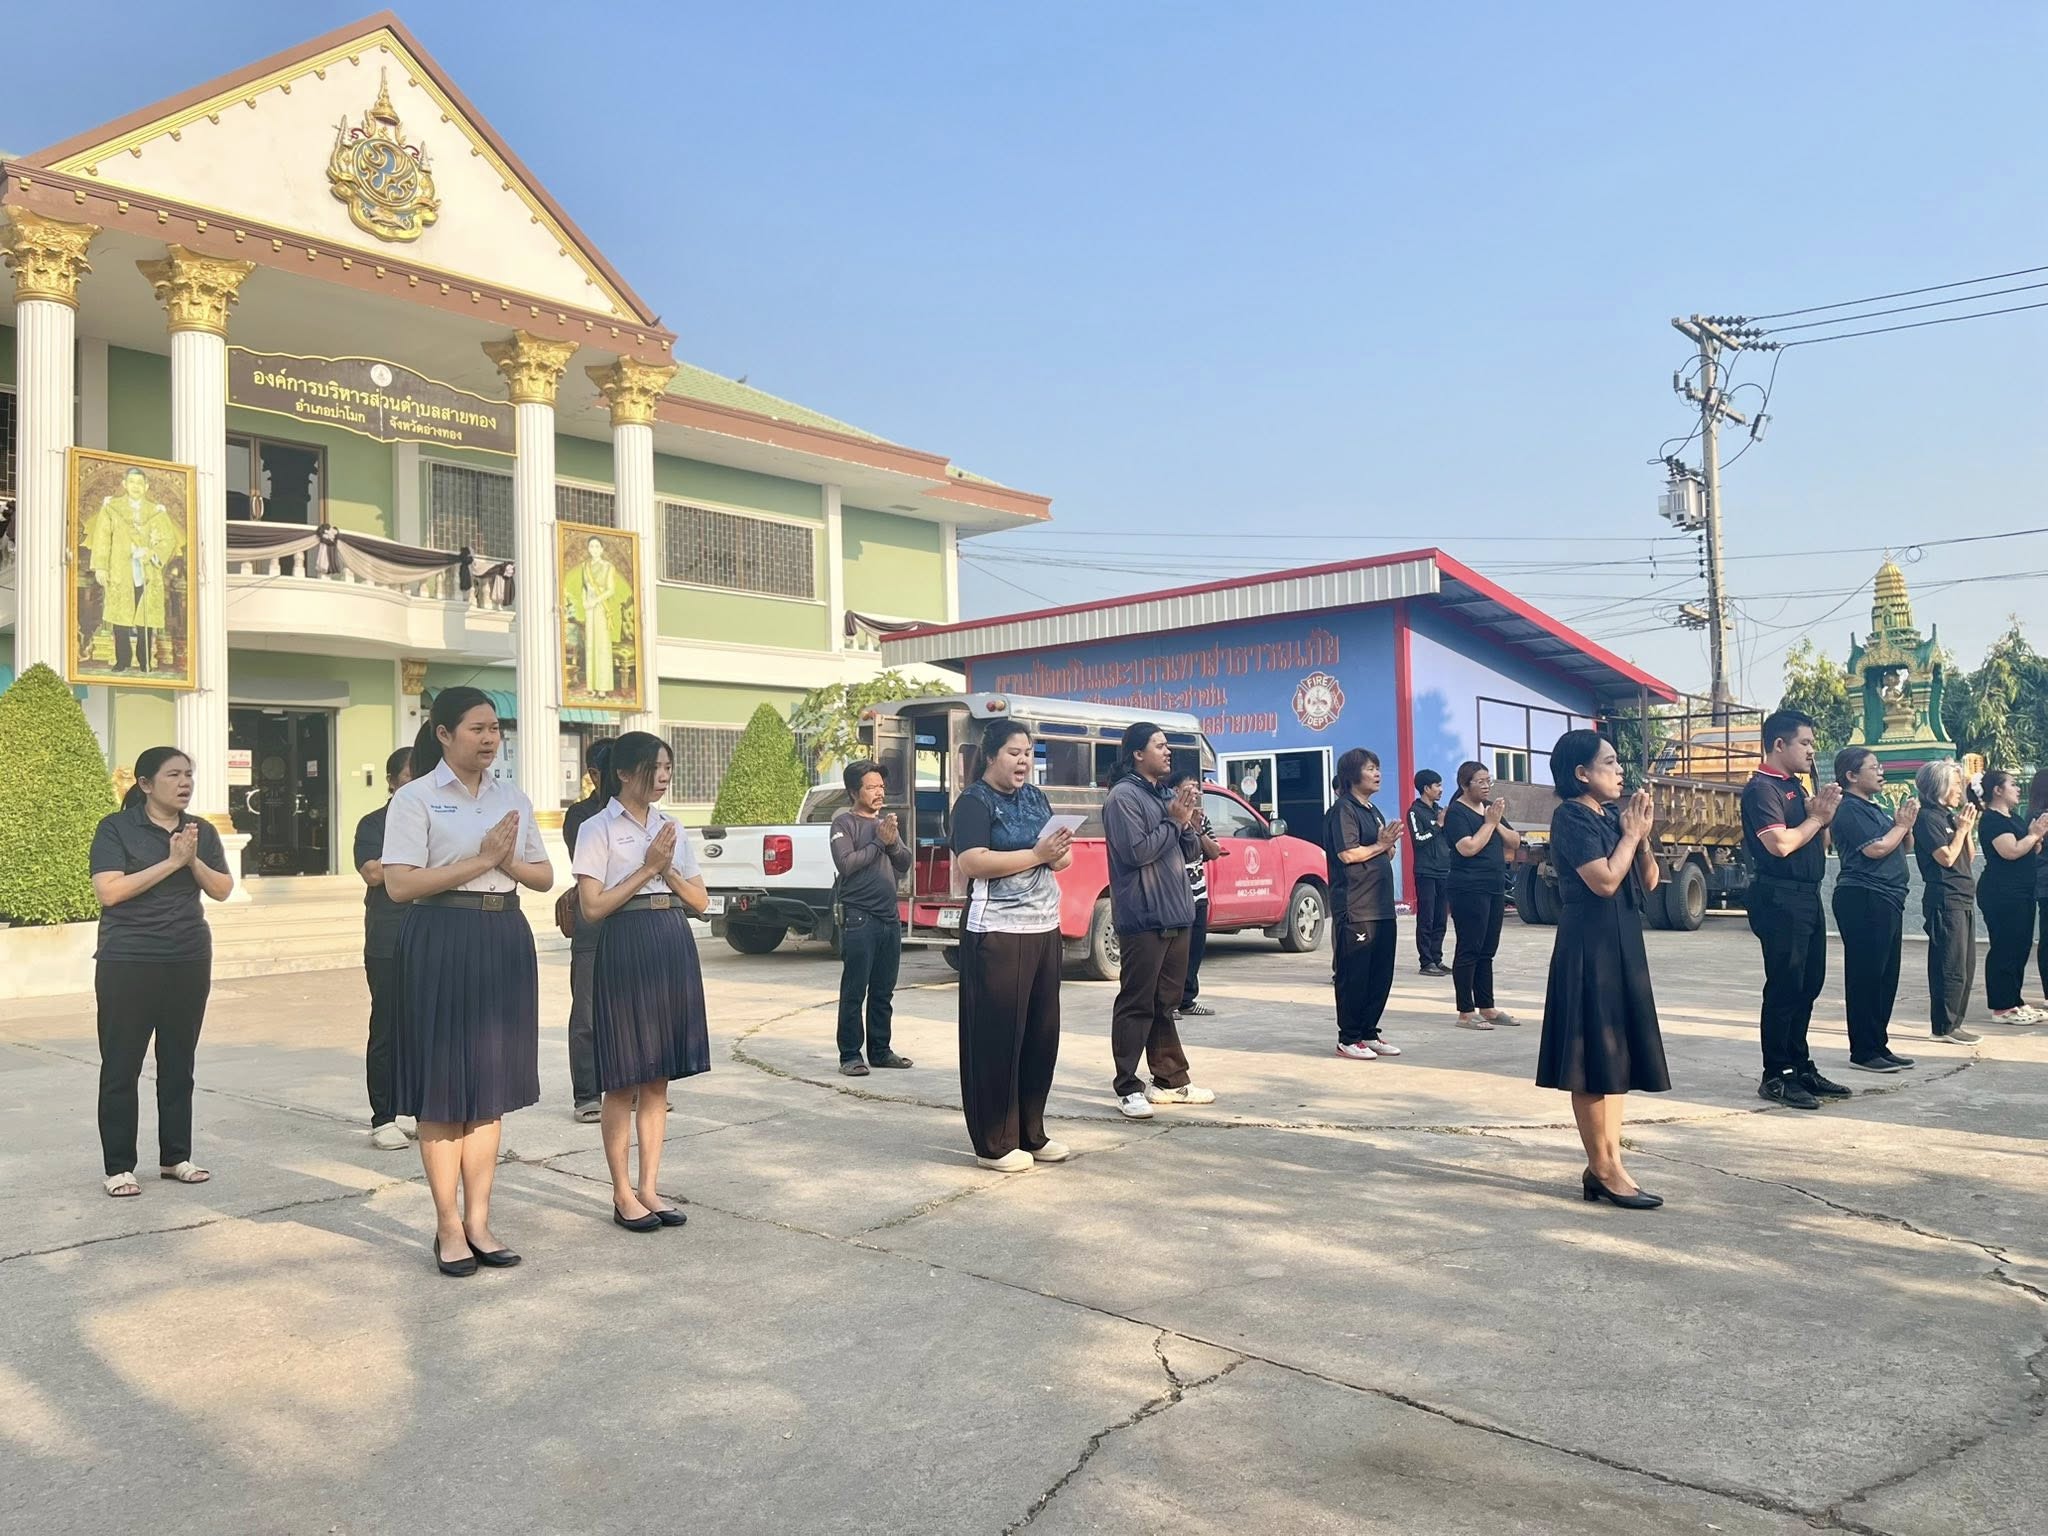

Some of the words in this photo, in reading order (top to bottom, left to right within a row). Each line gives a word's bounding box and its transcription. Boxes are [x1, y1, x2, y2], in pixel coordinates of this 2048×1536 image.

[253, 368, 497, 430] องค์การบริหารส่วนตำบลสายทอง
[295, 398, 366, 423] อำเภอป่าโมก
[389, 415, 463, 441] จังหวัดอ่างทอง
[1306, 675, 1329, 688] FIRE
[1306, 715, 1329, 727] DEPT
